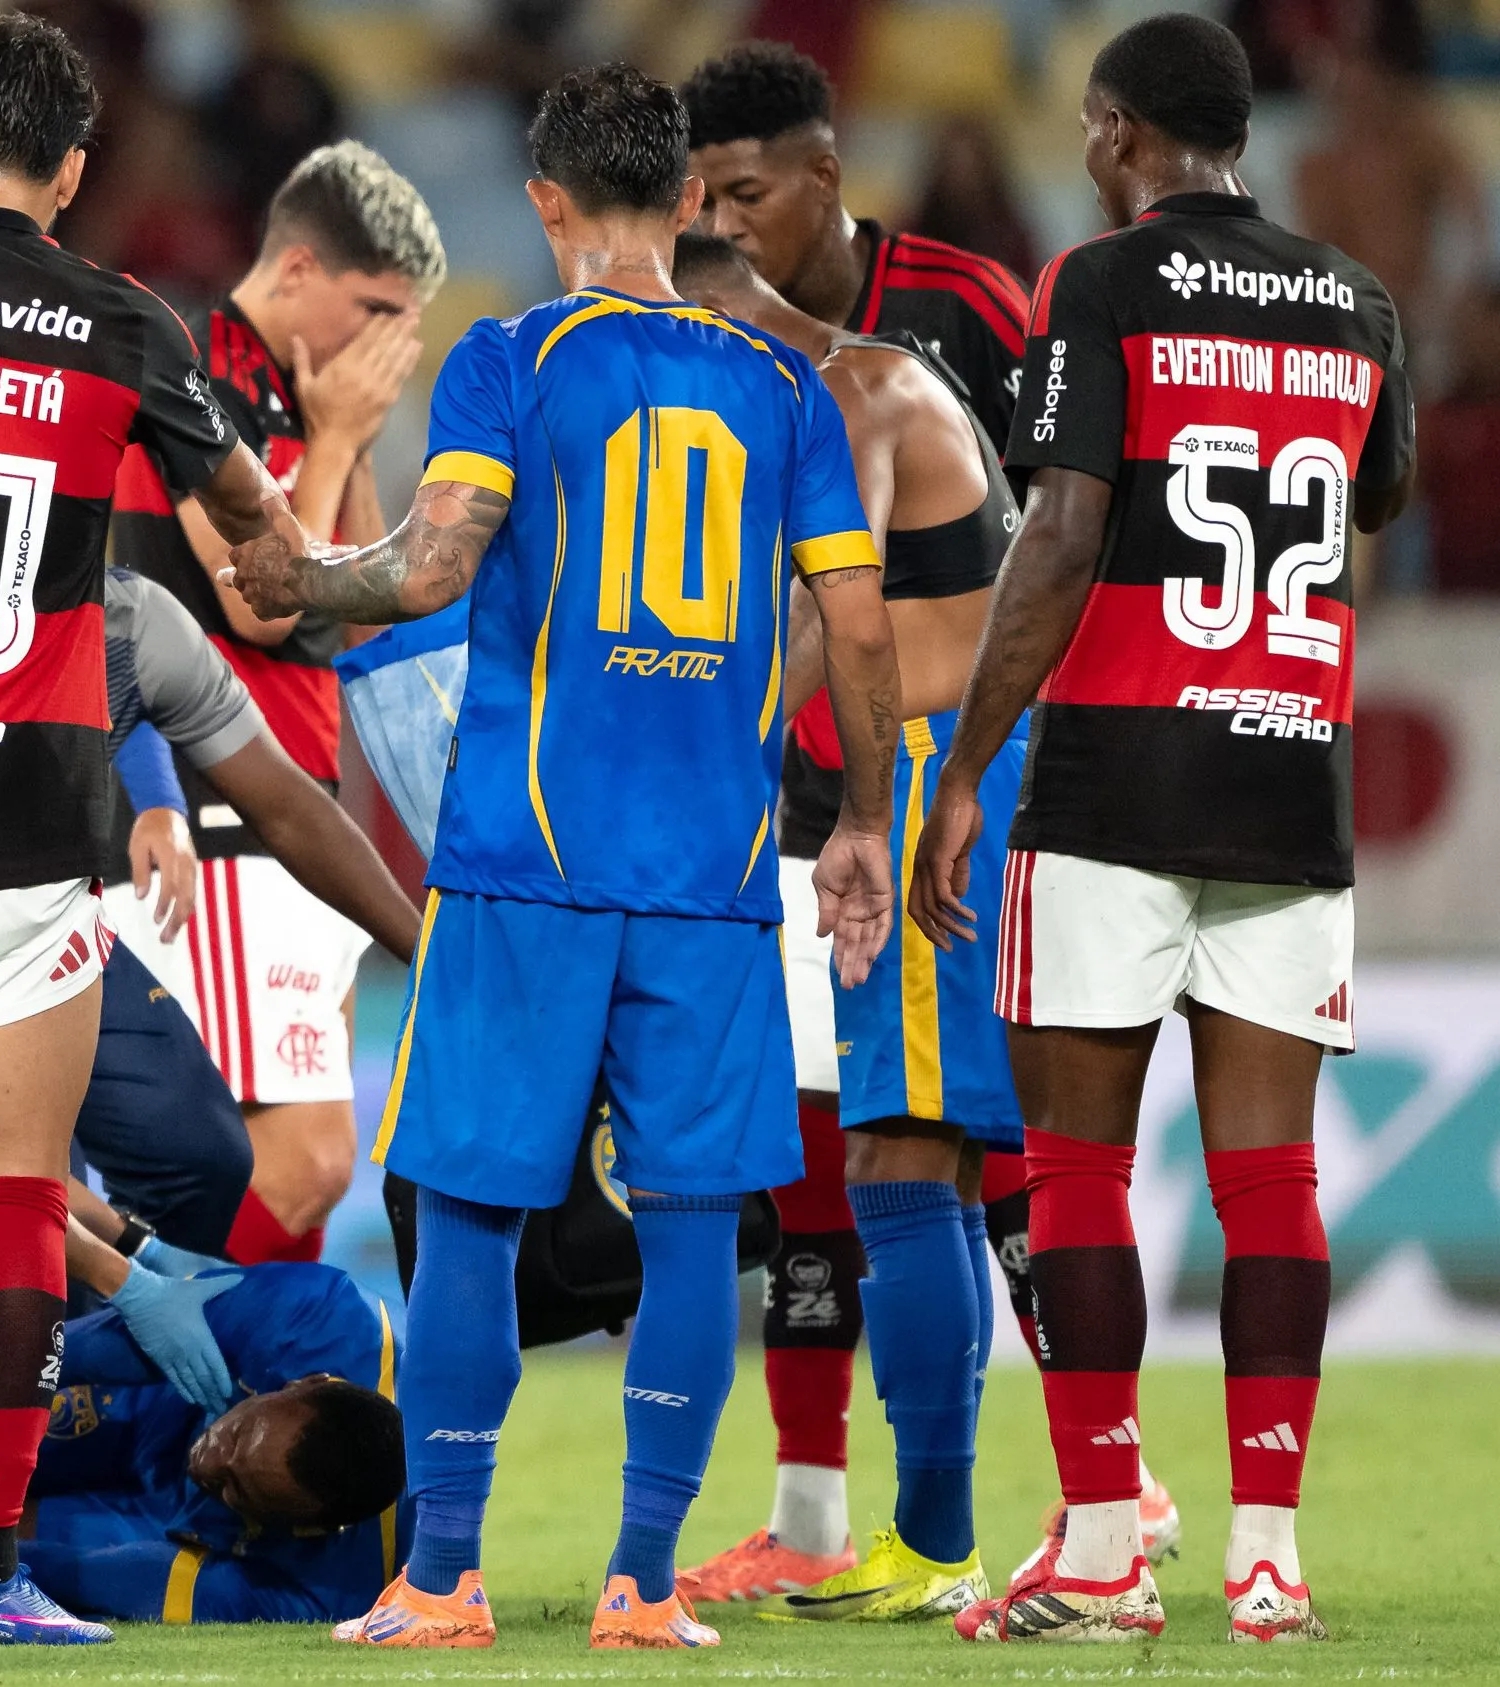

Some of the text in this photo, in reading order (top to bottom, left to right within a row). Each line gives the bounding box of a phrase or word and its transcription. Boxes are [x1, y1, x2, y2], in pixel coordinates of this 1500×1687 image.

[1209, 259, 1354, 311] Hapvida
[1033, 339, 1067, 442] Shopee
[1152, 337, 1371, 409] EVERTON ARAUJO
[1204, 440, 1256, 455] TEXACO
[597, 406, 747, 643] 10
[1334, 478, 1344, 538] TEXACO
[12, 529, 31, 589] TEXACO
[1163, 424, 1347, 666] 52
[604, 646, 724, 680] PRATIC
[1176, 686, 1322, 718] ASSIST
[1230, 711, 1332, 742] CARD
